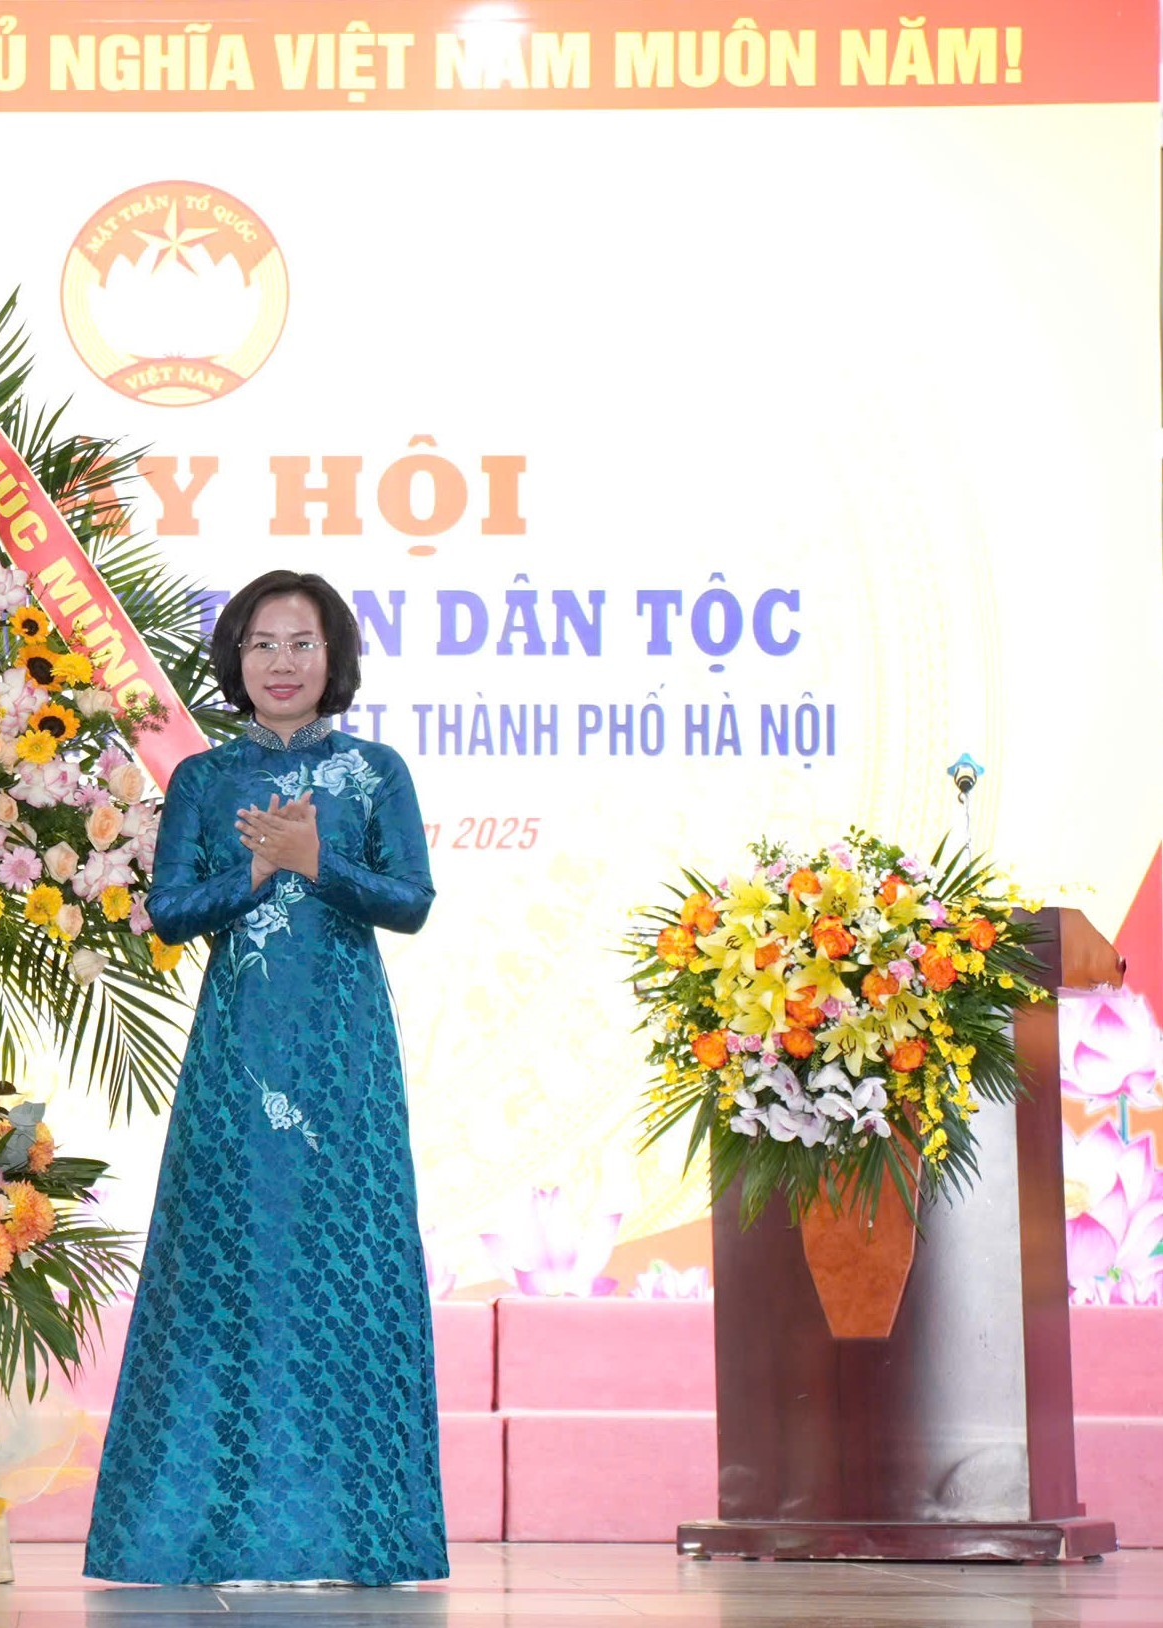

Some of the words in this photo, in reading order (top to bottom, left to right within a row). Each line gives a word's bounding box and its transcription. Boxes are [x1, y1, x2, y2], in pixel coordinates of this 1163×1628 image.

[50, 23, 254, 92] NGHĨA
[274, 20, 414, 103] VIỆT
[435, 32, 590, 90] NAM
[614, 18, 816, 88] MUÔN
[840, 16, 1022, 87] NĂM!
[179, 366, 225, 391] NAM
[269, 434, 526, 556] HỘI
[436, 573, 606, 657] DÂN
[635, 572, 801, 673] TỘC
[412, 692, 559, 757] THÀNH
[577, 683, 665, 757] PHỐ
[684, 691, 742, 757] HÀ
[760, 692, 836, 769] NỘI
[451, 817, 542, 850] 2025
